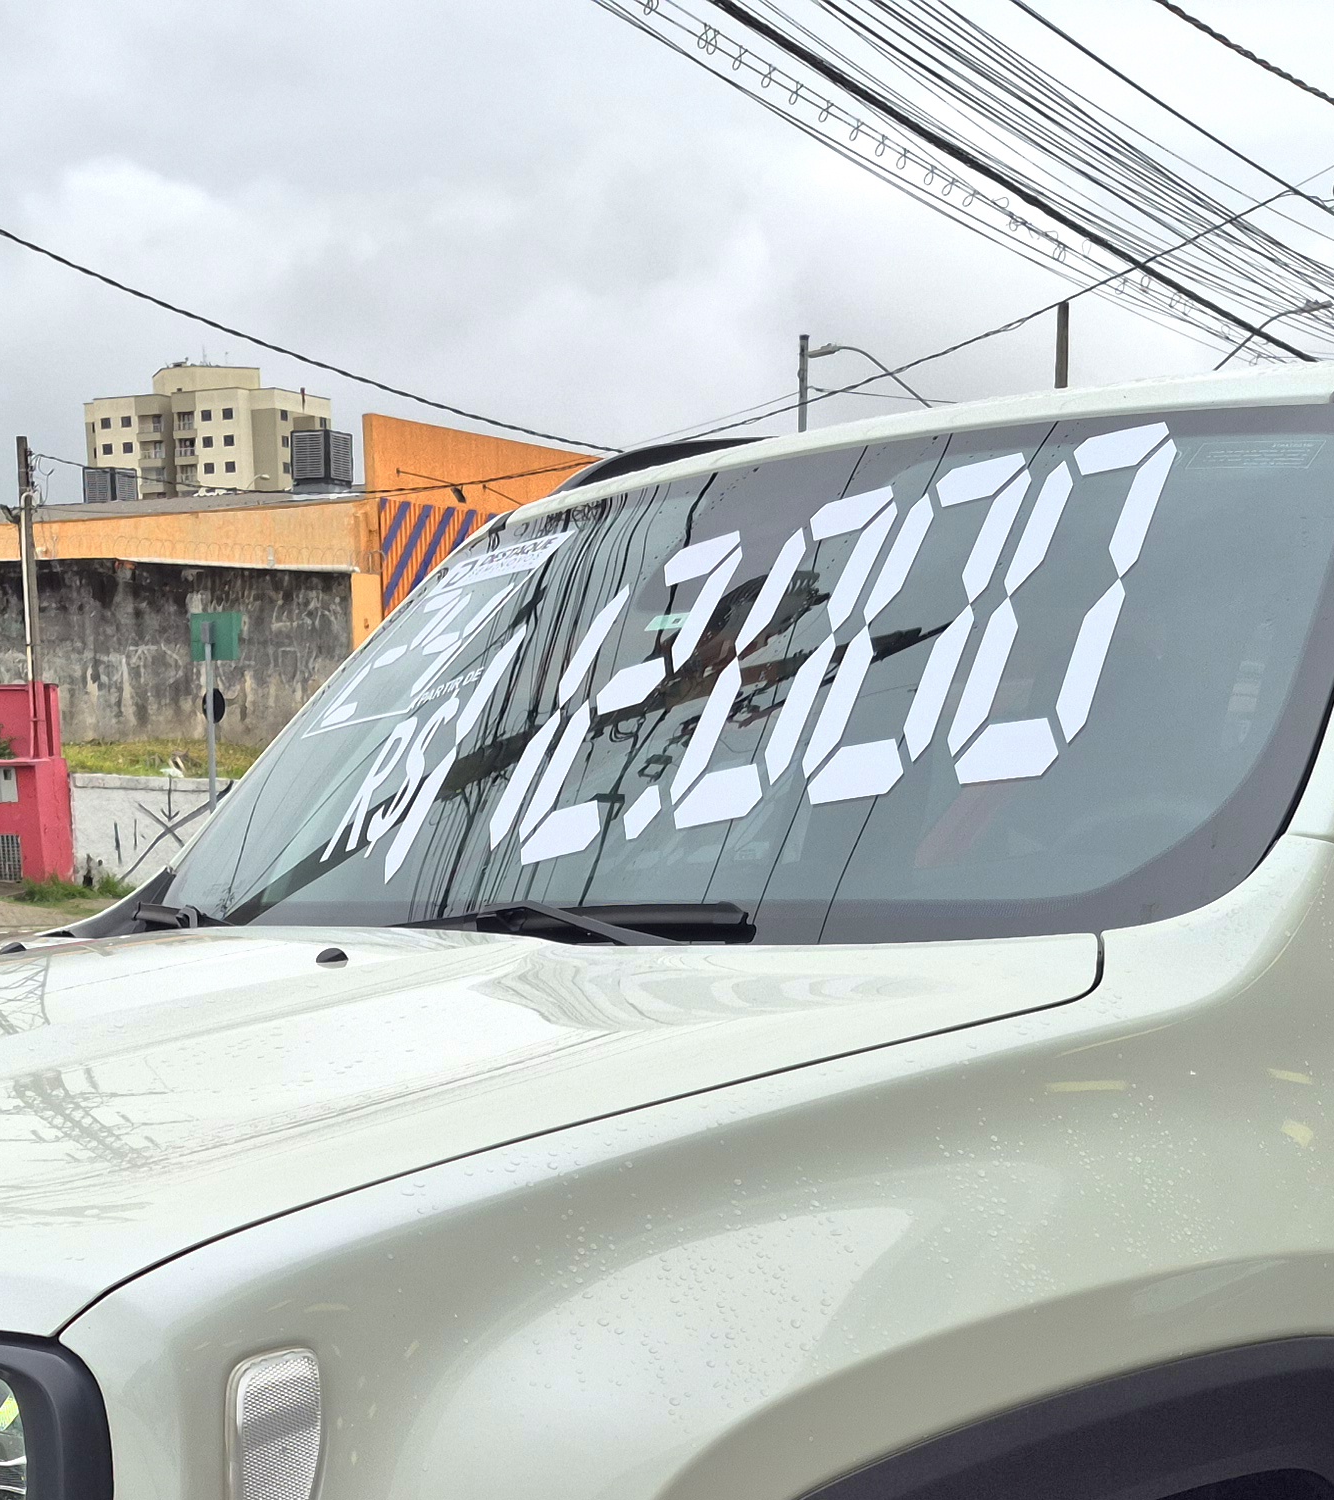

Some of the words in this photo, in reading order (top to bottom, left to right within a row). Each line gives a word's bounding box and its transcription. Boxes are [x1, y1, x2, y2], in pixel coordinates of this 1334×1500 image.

[480, 536, 558, 566] DESTAQUE
[422, 676, 464, 704] PARTIR
[462, 666, 485, 686] DE
[319, 688, 460, 863] R$
